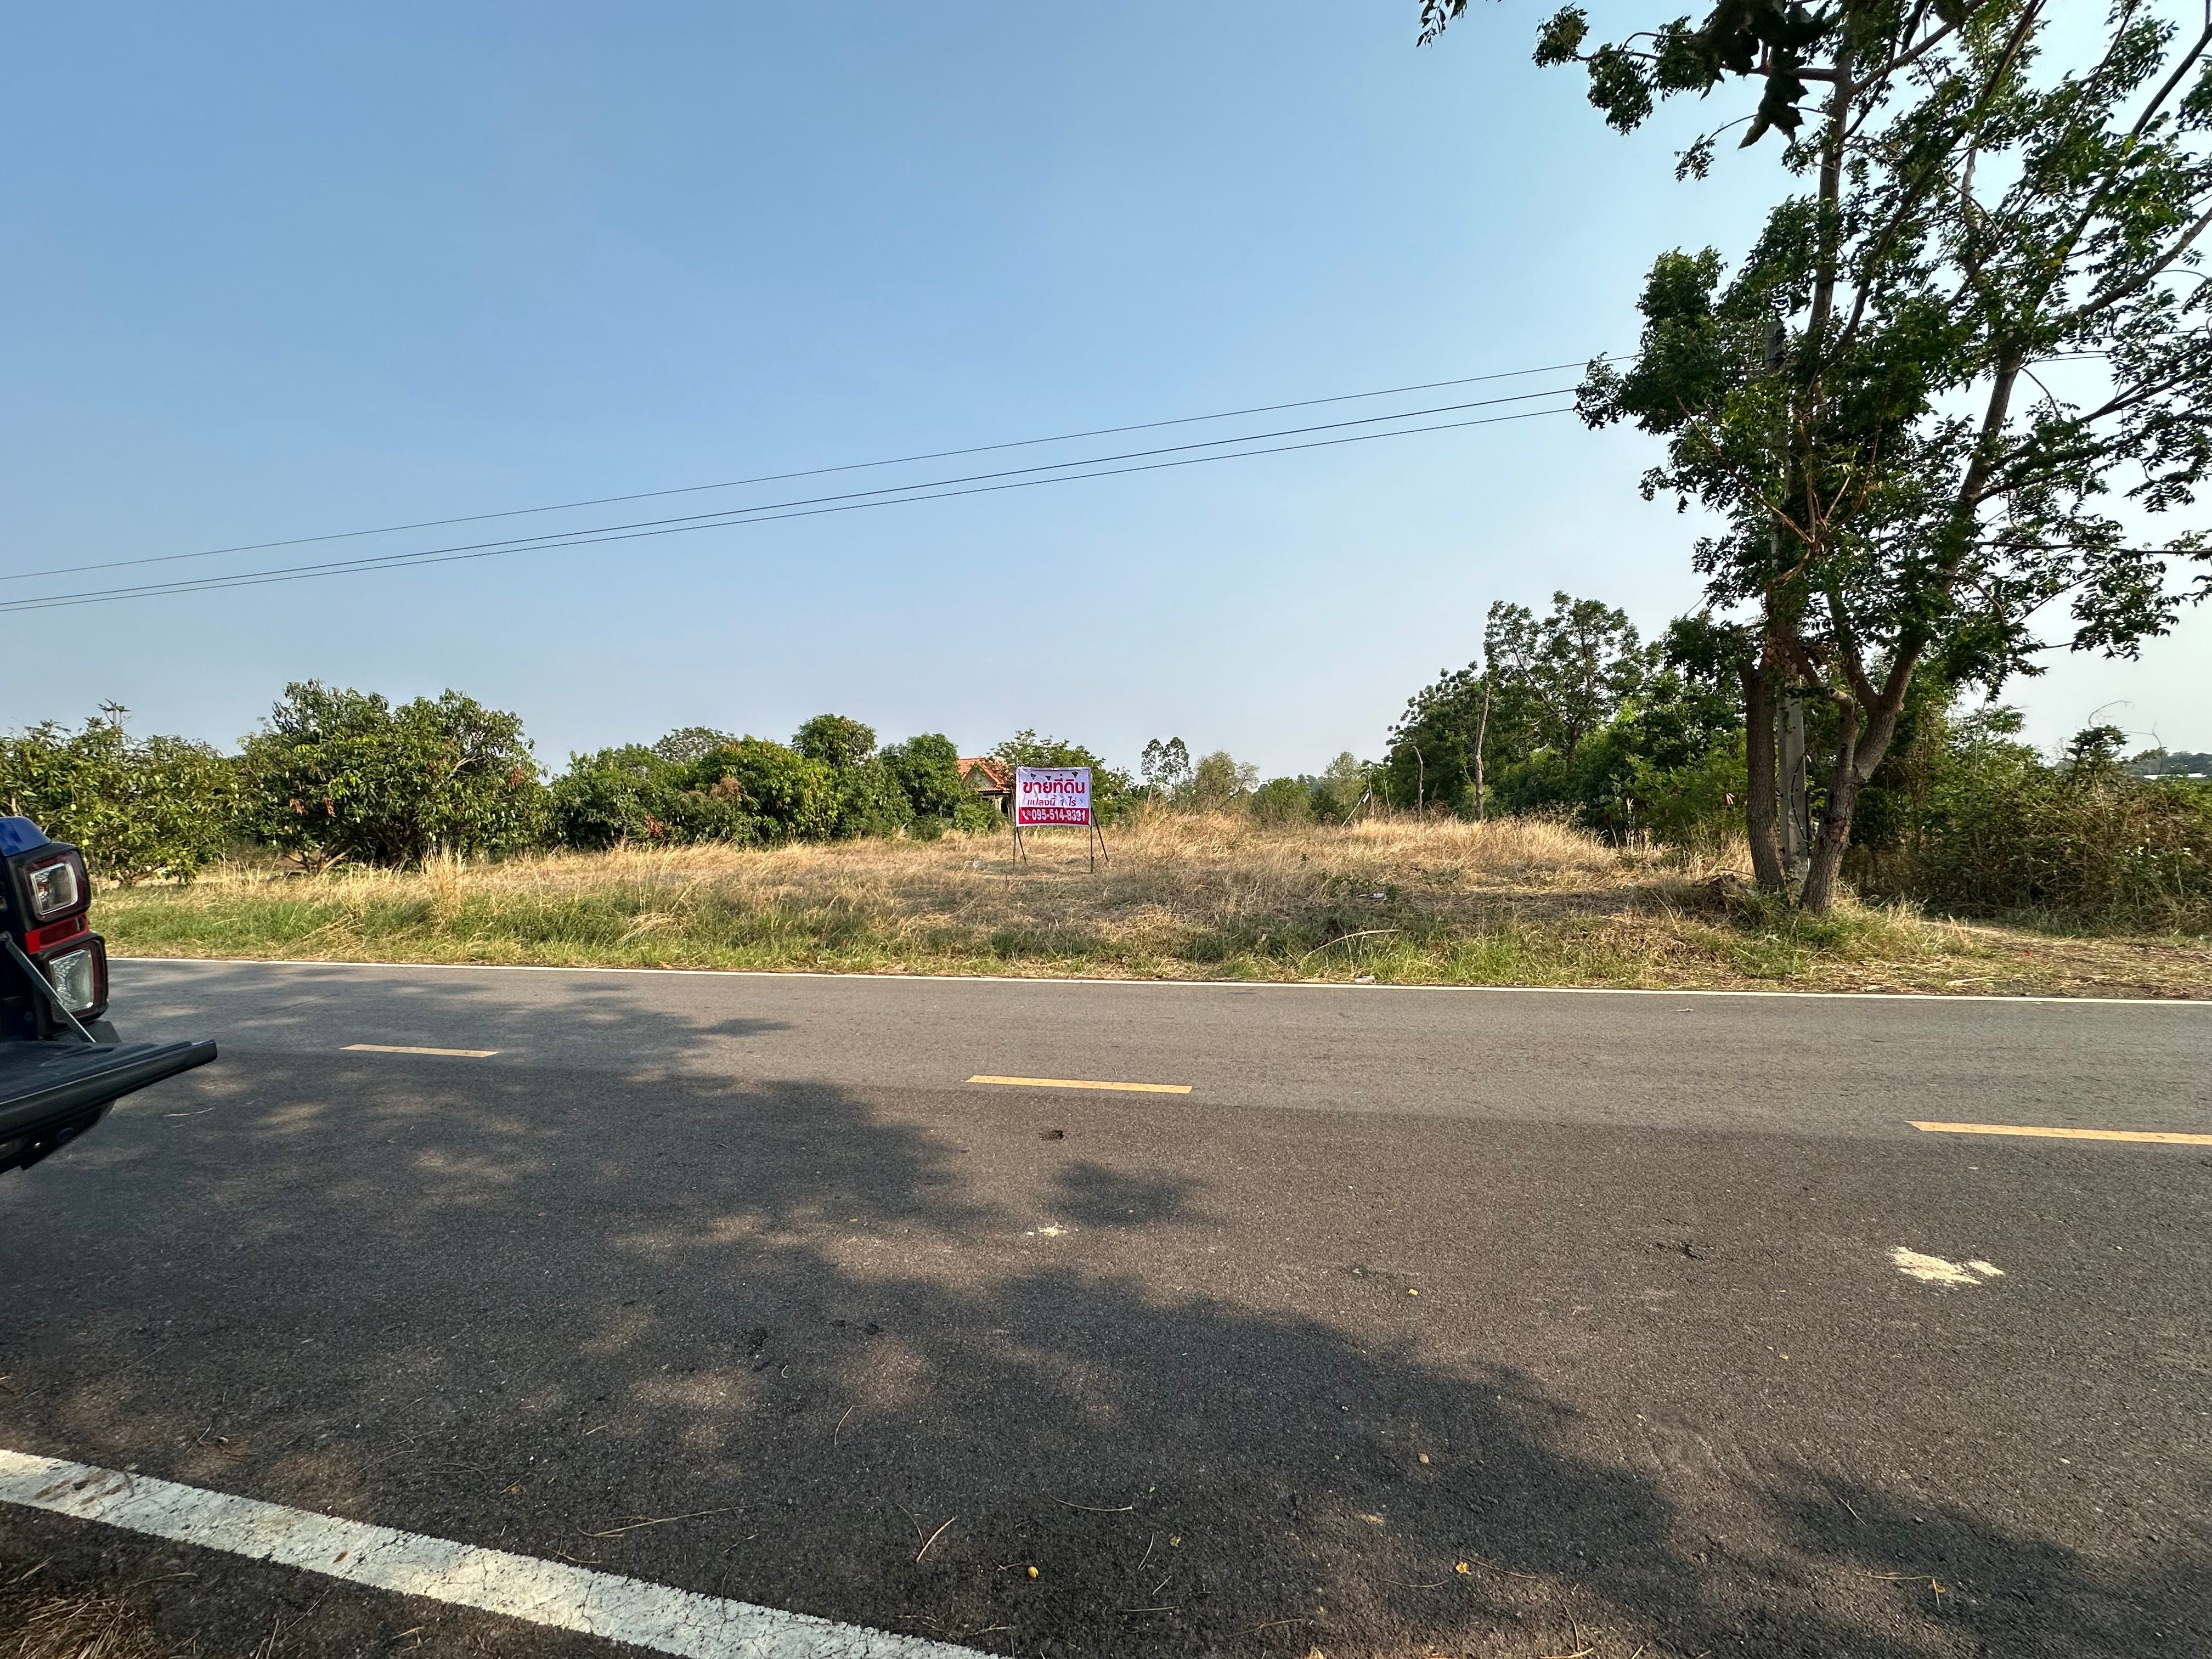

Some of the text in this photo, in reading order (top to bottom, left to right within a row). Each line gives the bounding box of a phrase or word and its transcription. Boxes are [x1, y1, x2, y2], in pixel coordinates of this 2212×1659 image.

[1023, 774, 1085, 794] ขายที่ดิน
[1027, 794, 1057, 806] แปลงนี้
[1068, 795, 1077, 806] ไร่
[1031, 809, 1086, 822] 095-514-8391
